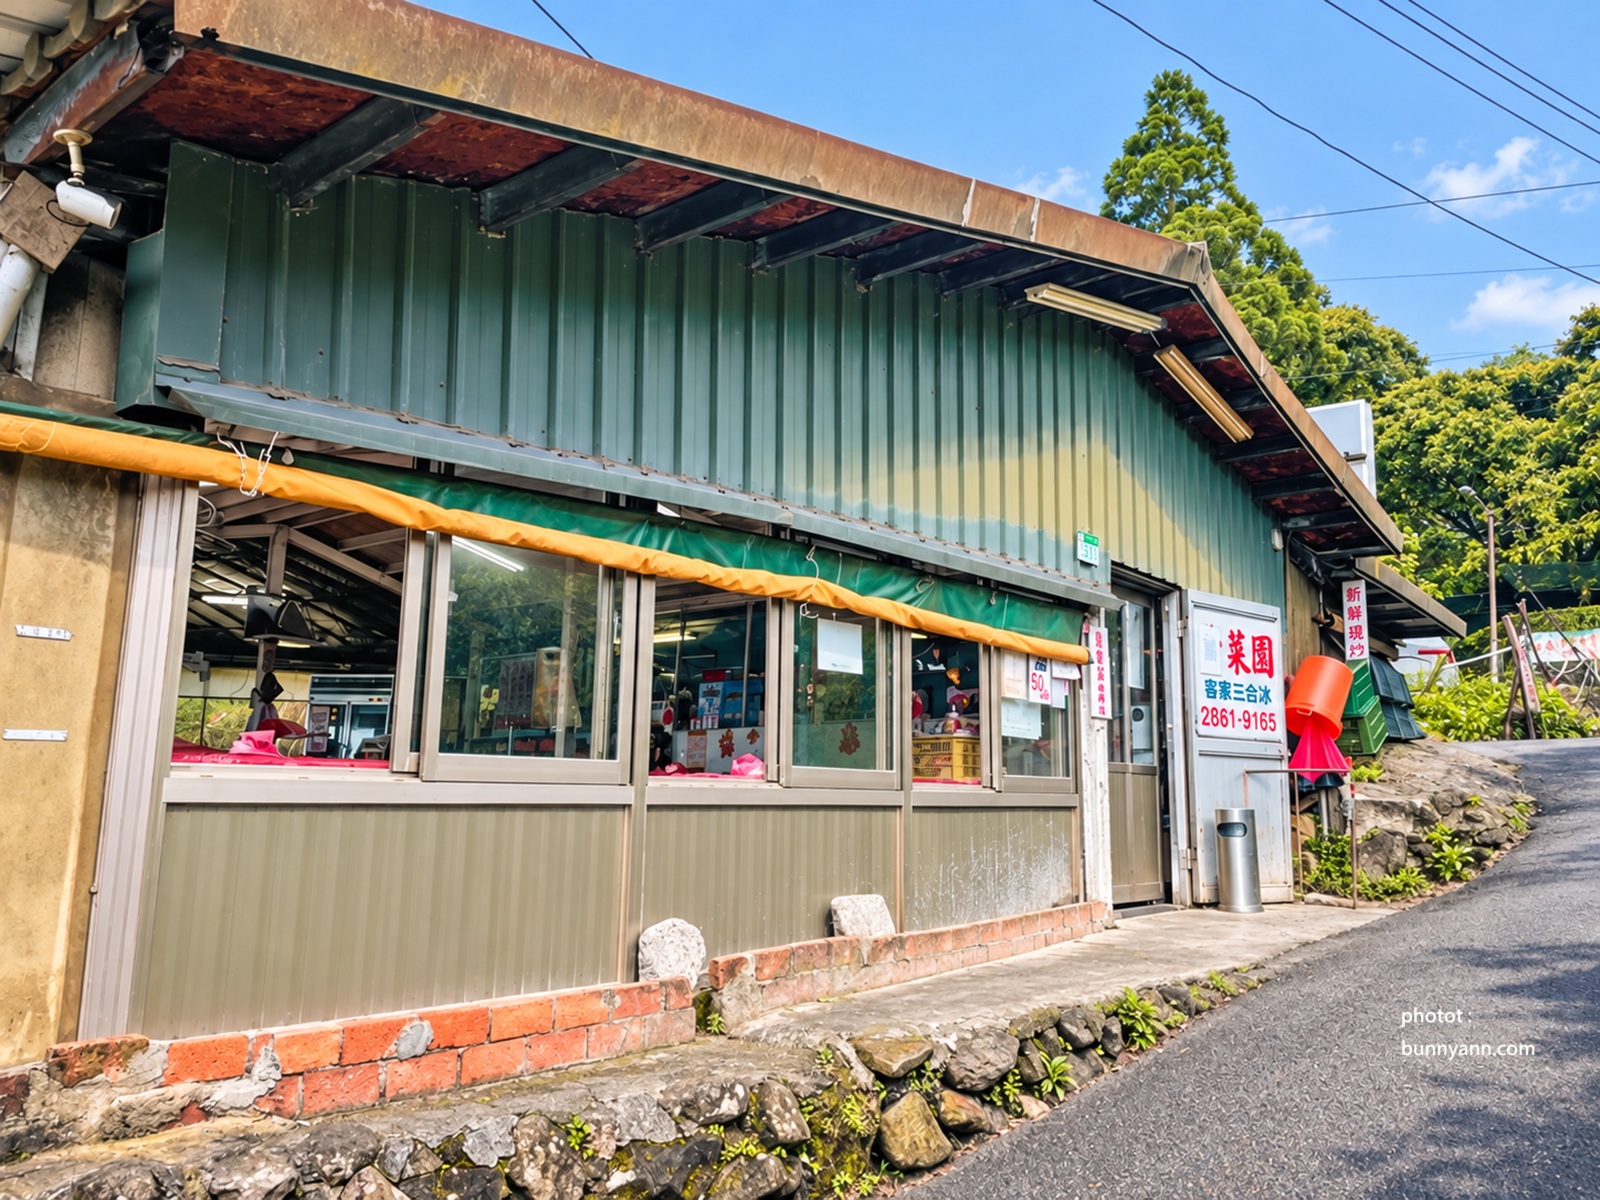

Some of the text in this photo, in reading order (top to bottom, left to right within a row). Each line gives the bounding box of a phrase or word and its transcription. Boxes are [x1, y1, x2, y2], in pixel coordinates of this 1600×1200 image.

[1346, 586, 1365, 658] 新鮮現炒
[1227, 629, 1274, 679] 菜園
[1204, 678, 1272, 705] 客家三合冰
[1201, 705, 1277, 732] 2861-9165
